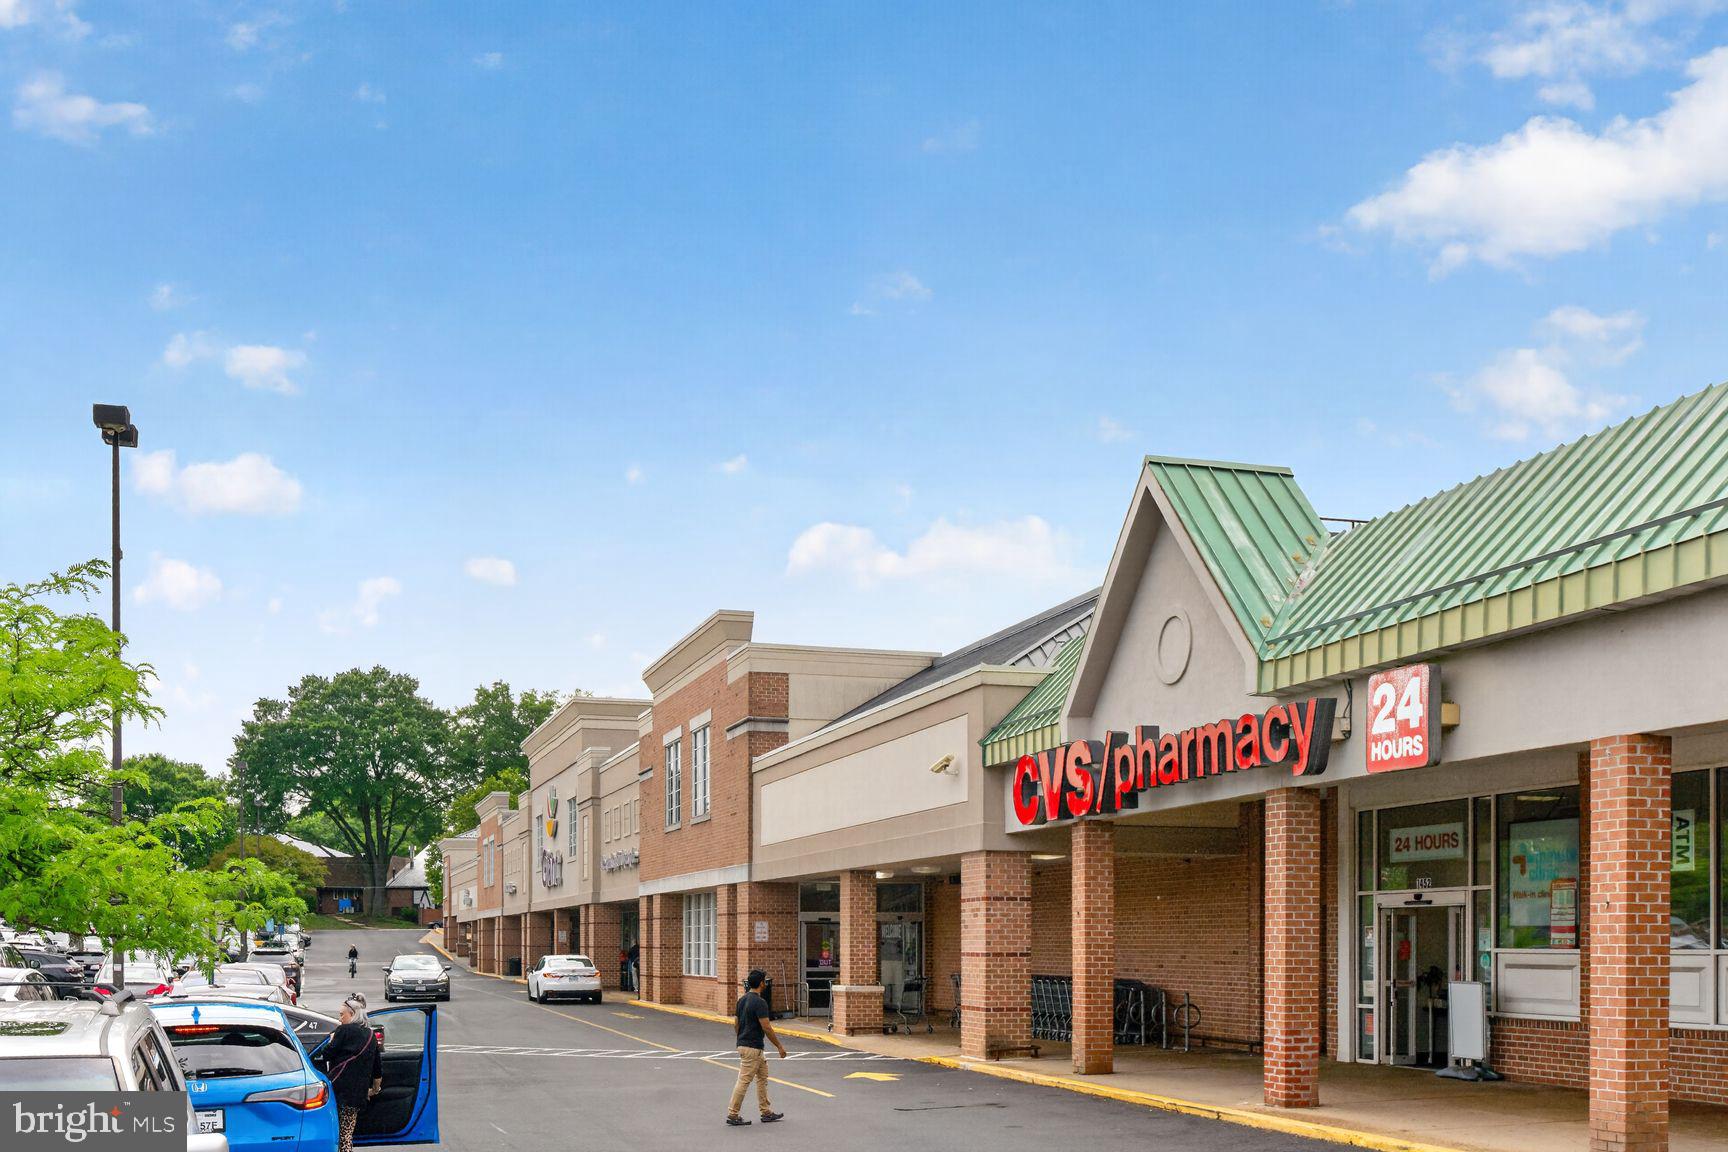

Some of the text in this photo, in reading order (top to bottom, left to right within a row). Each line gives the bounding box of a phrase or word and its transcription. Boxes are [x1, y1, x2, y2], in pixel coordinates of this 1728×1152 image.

[1372, 676, 1423, 734] 24
[1013, 697, 1319, 826] CVS/pharmacy
[1371, 734, 1424, 762] HOURS
[1395, 831, 1459, 853] 24 HOURS
[1675, 816, 1690, 865] ATM
[309, 1021, 318, 1030] 47
